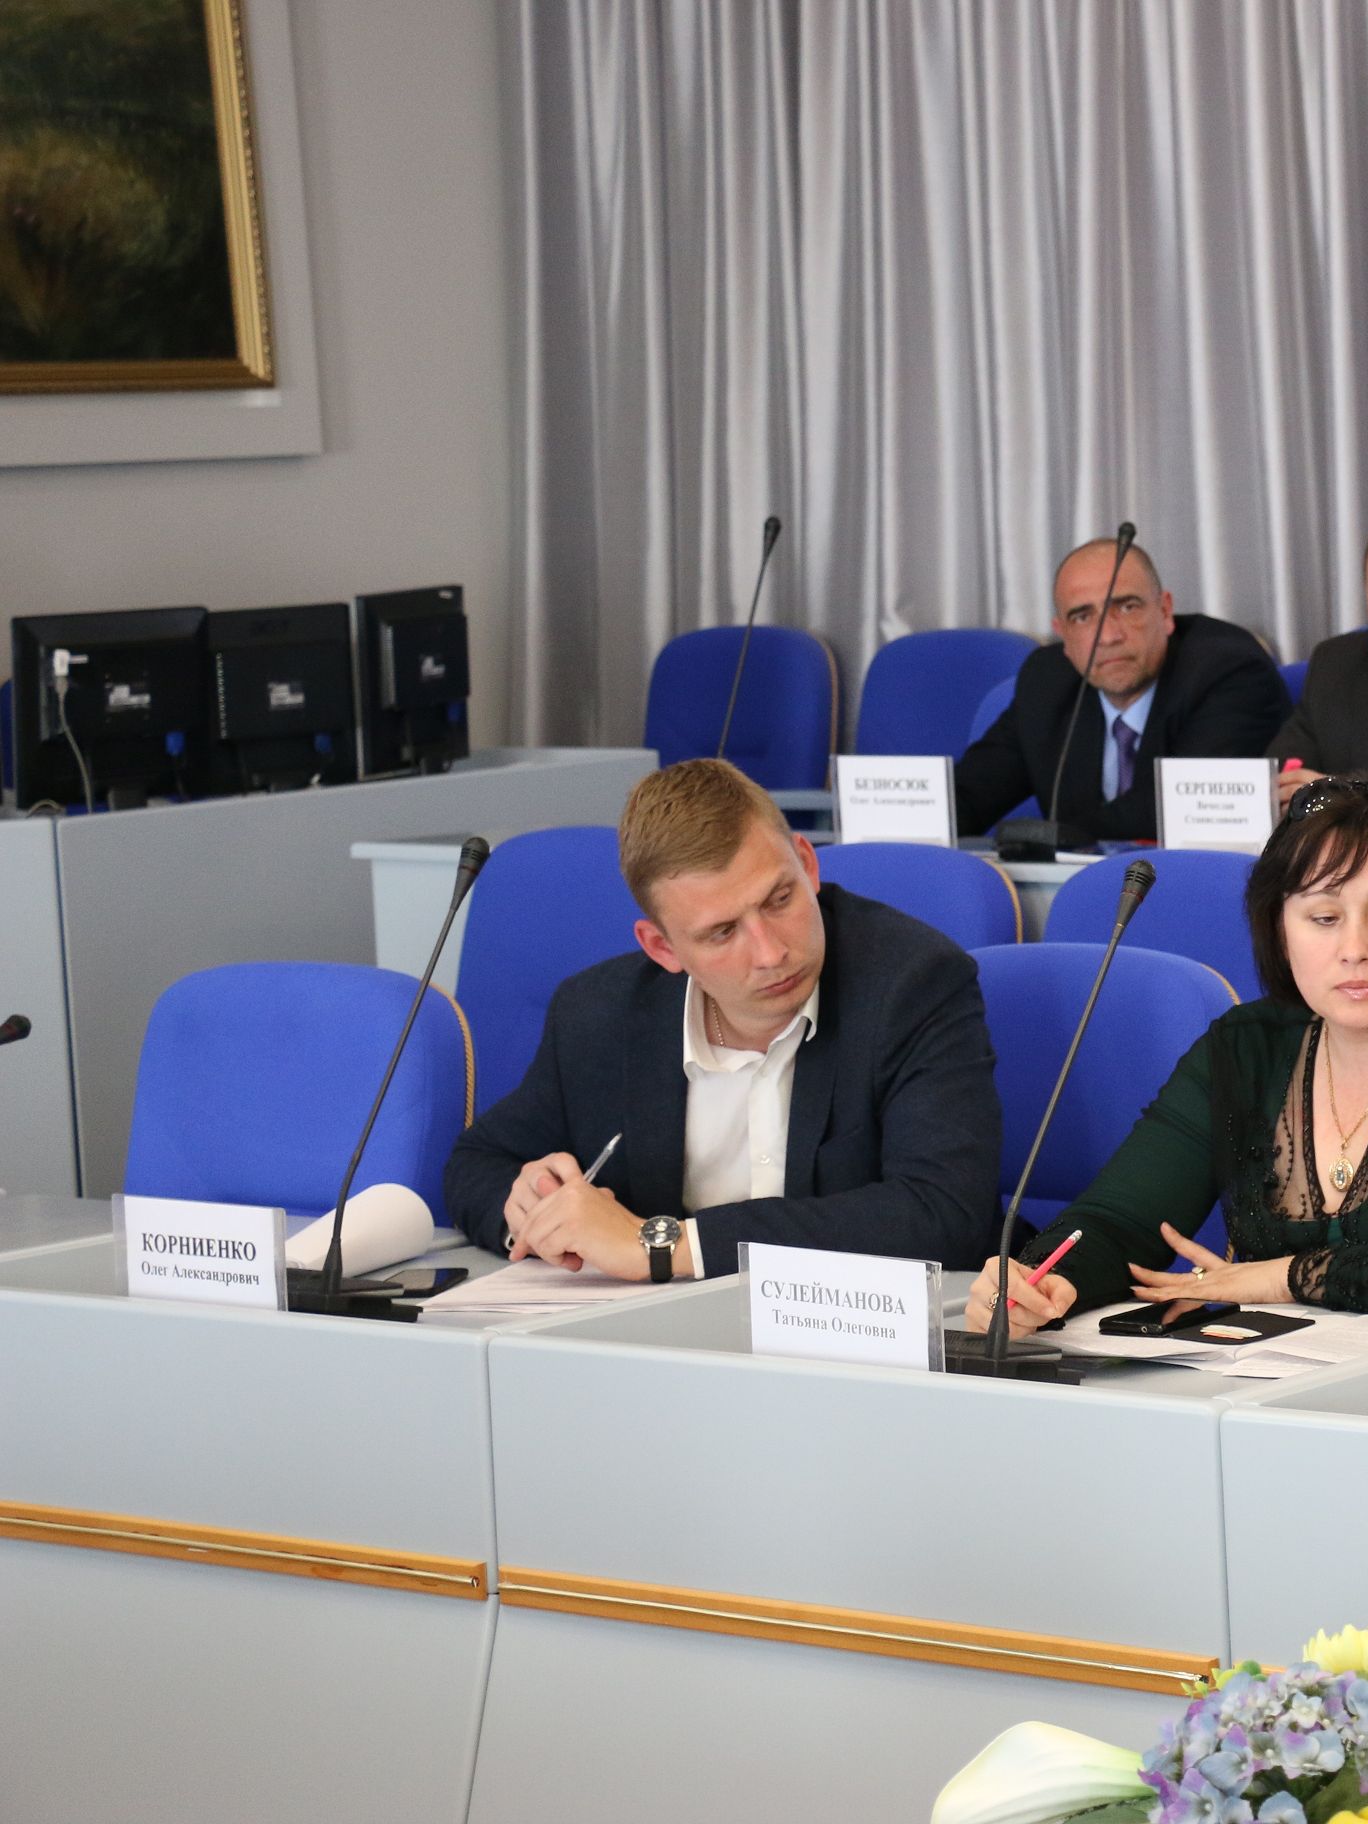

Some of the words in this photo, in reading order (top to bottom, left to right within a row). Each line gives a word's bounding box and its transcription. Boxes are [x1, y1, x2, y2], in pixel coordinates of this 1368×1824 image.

[854, 778, 928, 791] БЕЗНОСЮК
[1175, 782, 1255, 795] СЕРГИЕНКО
[142, 1232, 257, 1262] КОРНИЕНКО
[141, 1261, 168, 1276] Олег
[172, 1264, 260, 1286] Александрович
[760, 1281, 906, 1315] СУЛЕЙМАНОВА
[772, 1308, 828, 1330] Татьяна
[831, 1316, 896, 1339] Олеговна
